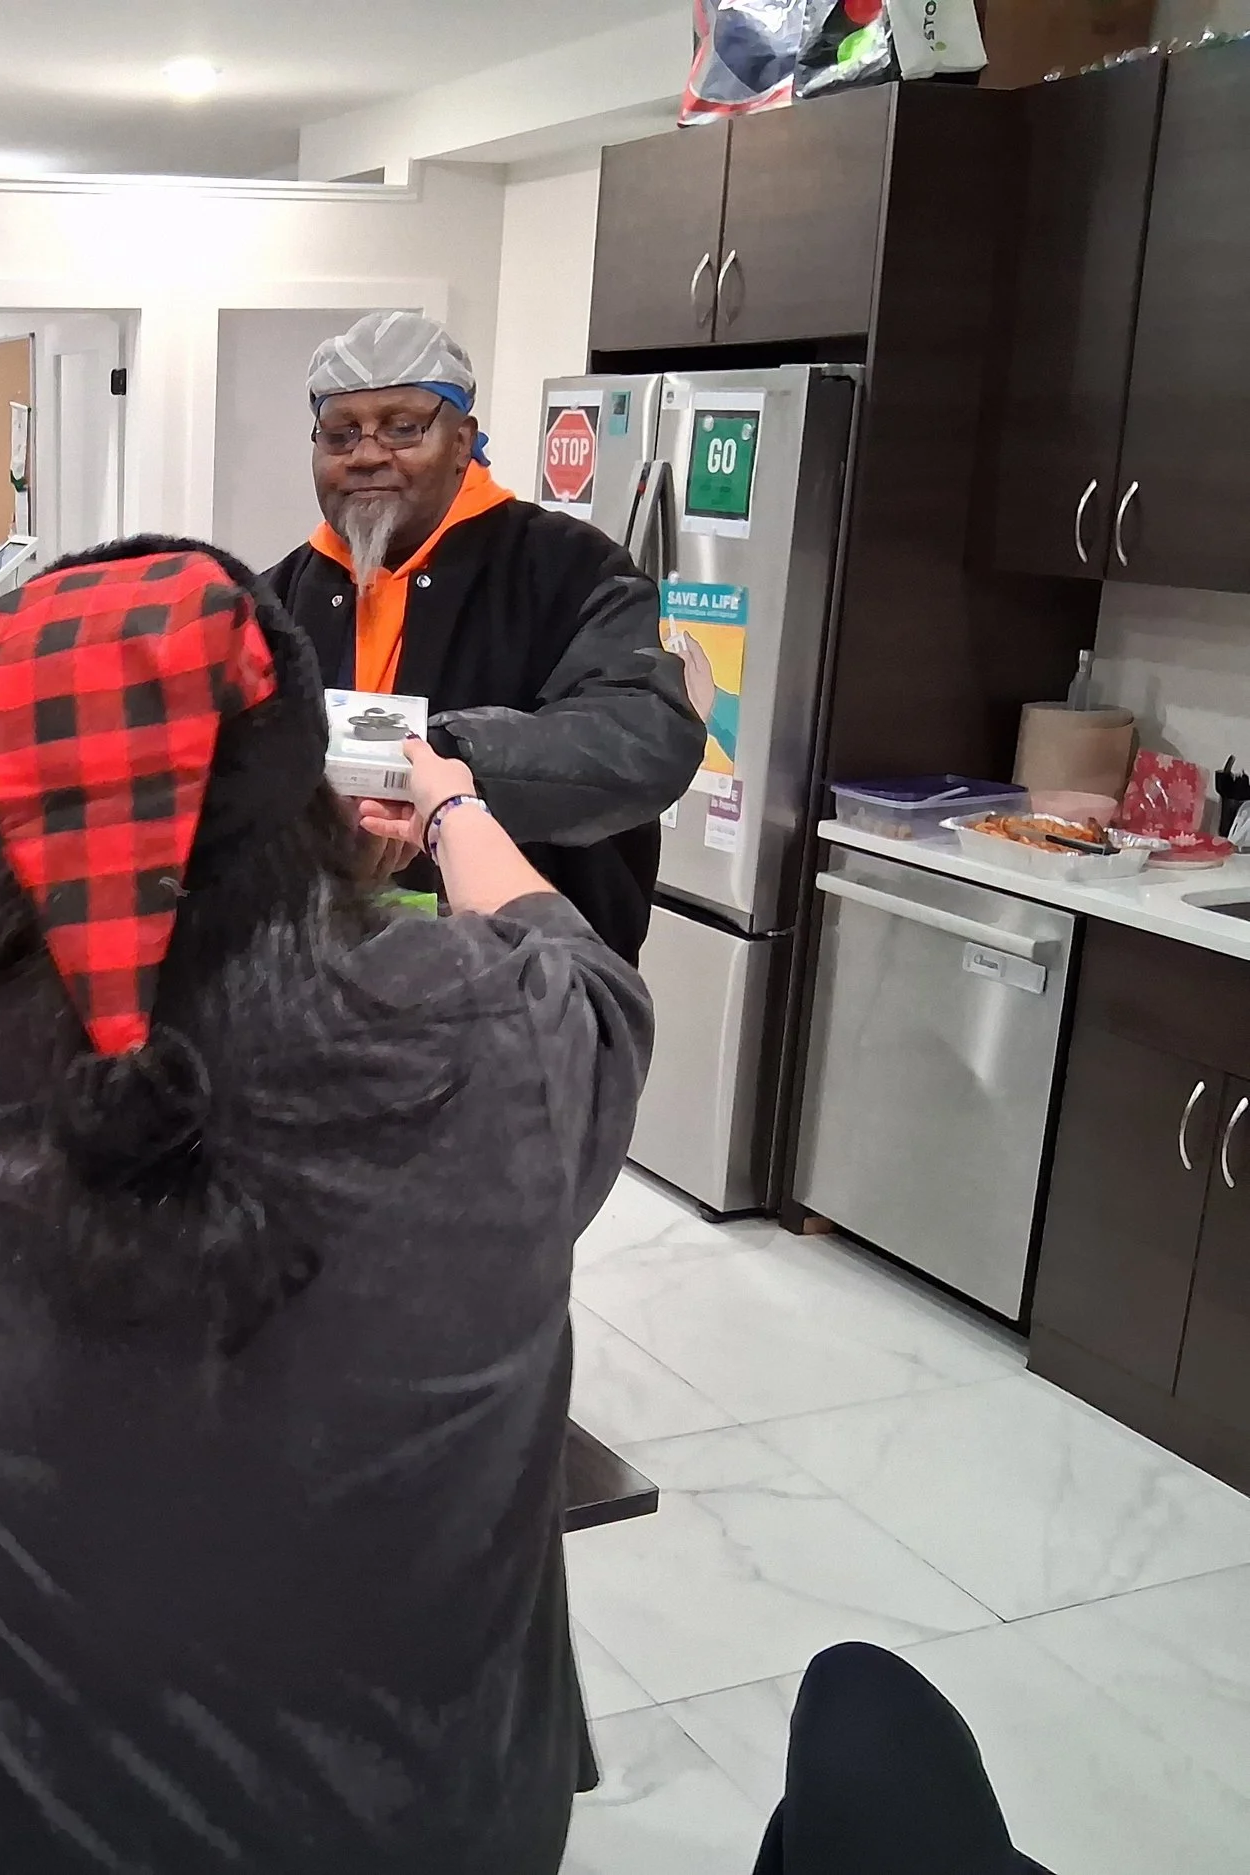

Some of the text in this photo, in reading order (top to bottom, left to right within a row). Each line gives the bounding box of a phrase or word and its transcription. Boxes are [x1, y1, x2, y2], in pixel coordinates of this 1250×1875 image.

[549, 437, 590, 466] STOP
[707, 437, 738, 475] GO
[667, 591, 740, 610] SAVE A LIFE
